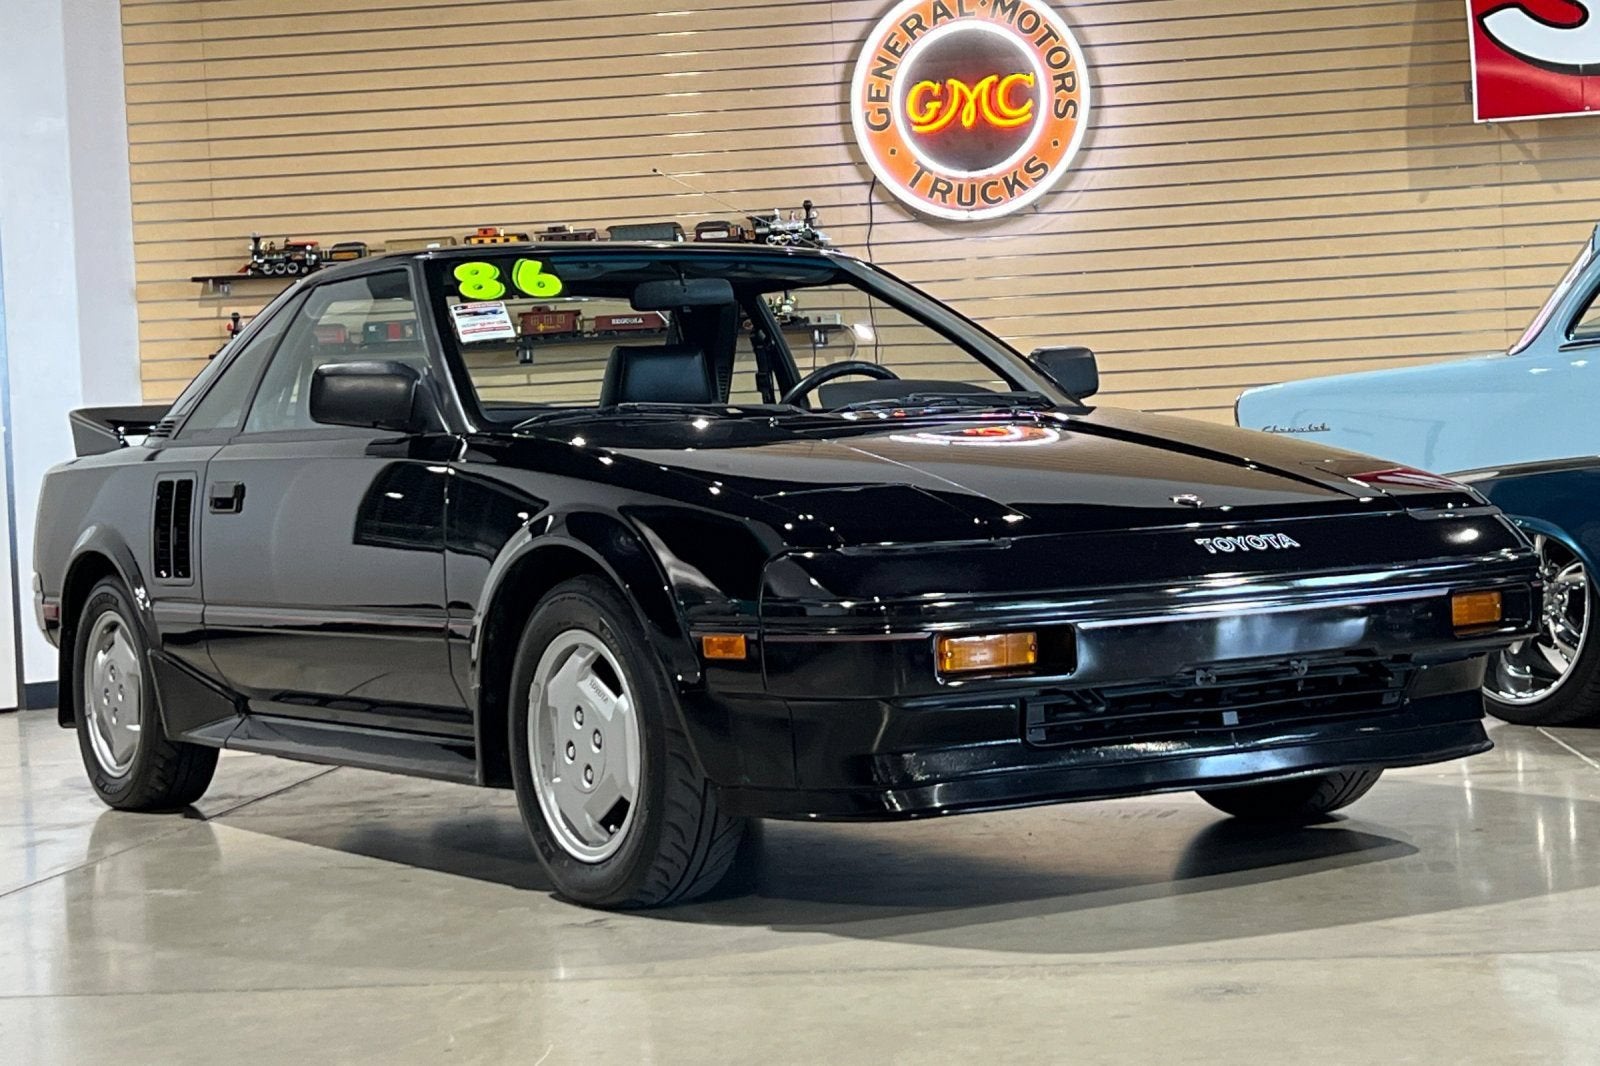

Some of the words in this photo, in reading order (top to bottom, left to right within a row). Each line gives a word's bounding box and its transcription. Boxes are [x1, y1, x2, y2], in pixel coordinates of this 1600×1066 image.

[864, 0, 976, 132] GENERAL
[990, 0, 1078, 120] MOTORS
[906, 72, 1035, 132] GMC
[908, 156, 1050, 208] TRUCKS
[1194, 533, 1301, 554] TOYOTA
